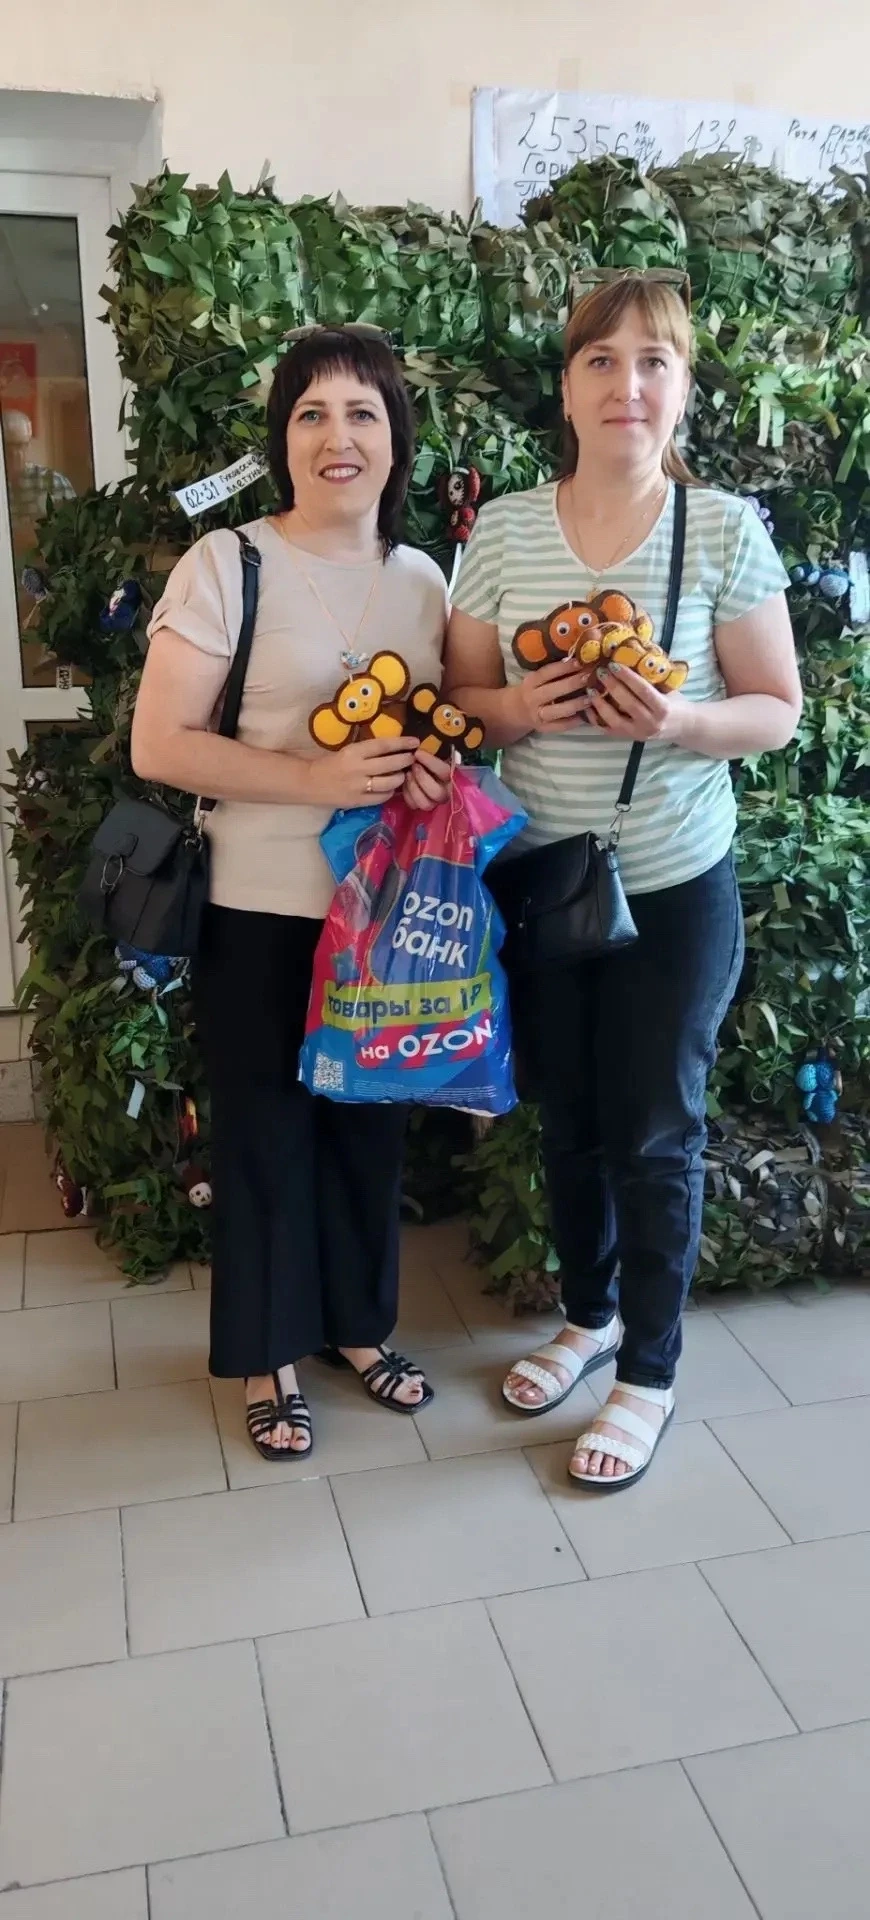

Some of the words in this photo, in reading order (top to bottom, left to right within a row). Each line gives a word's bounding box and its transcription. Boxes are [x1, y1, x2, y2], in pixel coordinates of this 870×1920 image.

[403, 891, 474, 932] ozon
[392, 917, 469, 968] банк
[328, 995, 411, 1025] товары
[420, 996, 451, 1016] за
[360, 1045, 390, 1060] на
[397, 1018, 493, 1058] OZON
